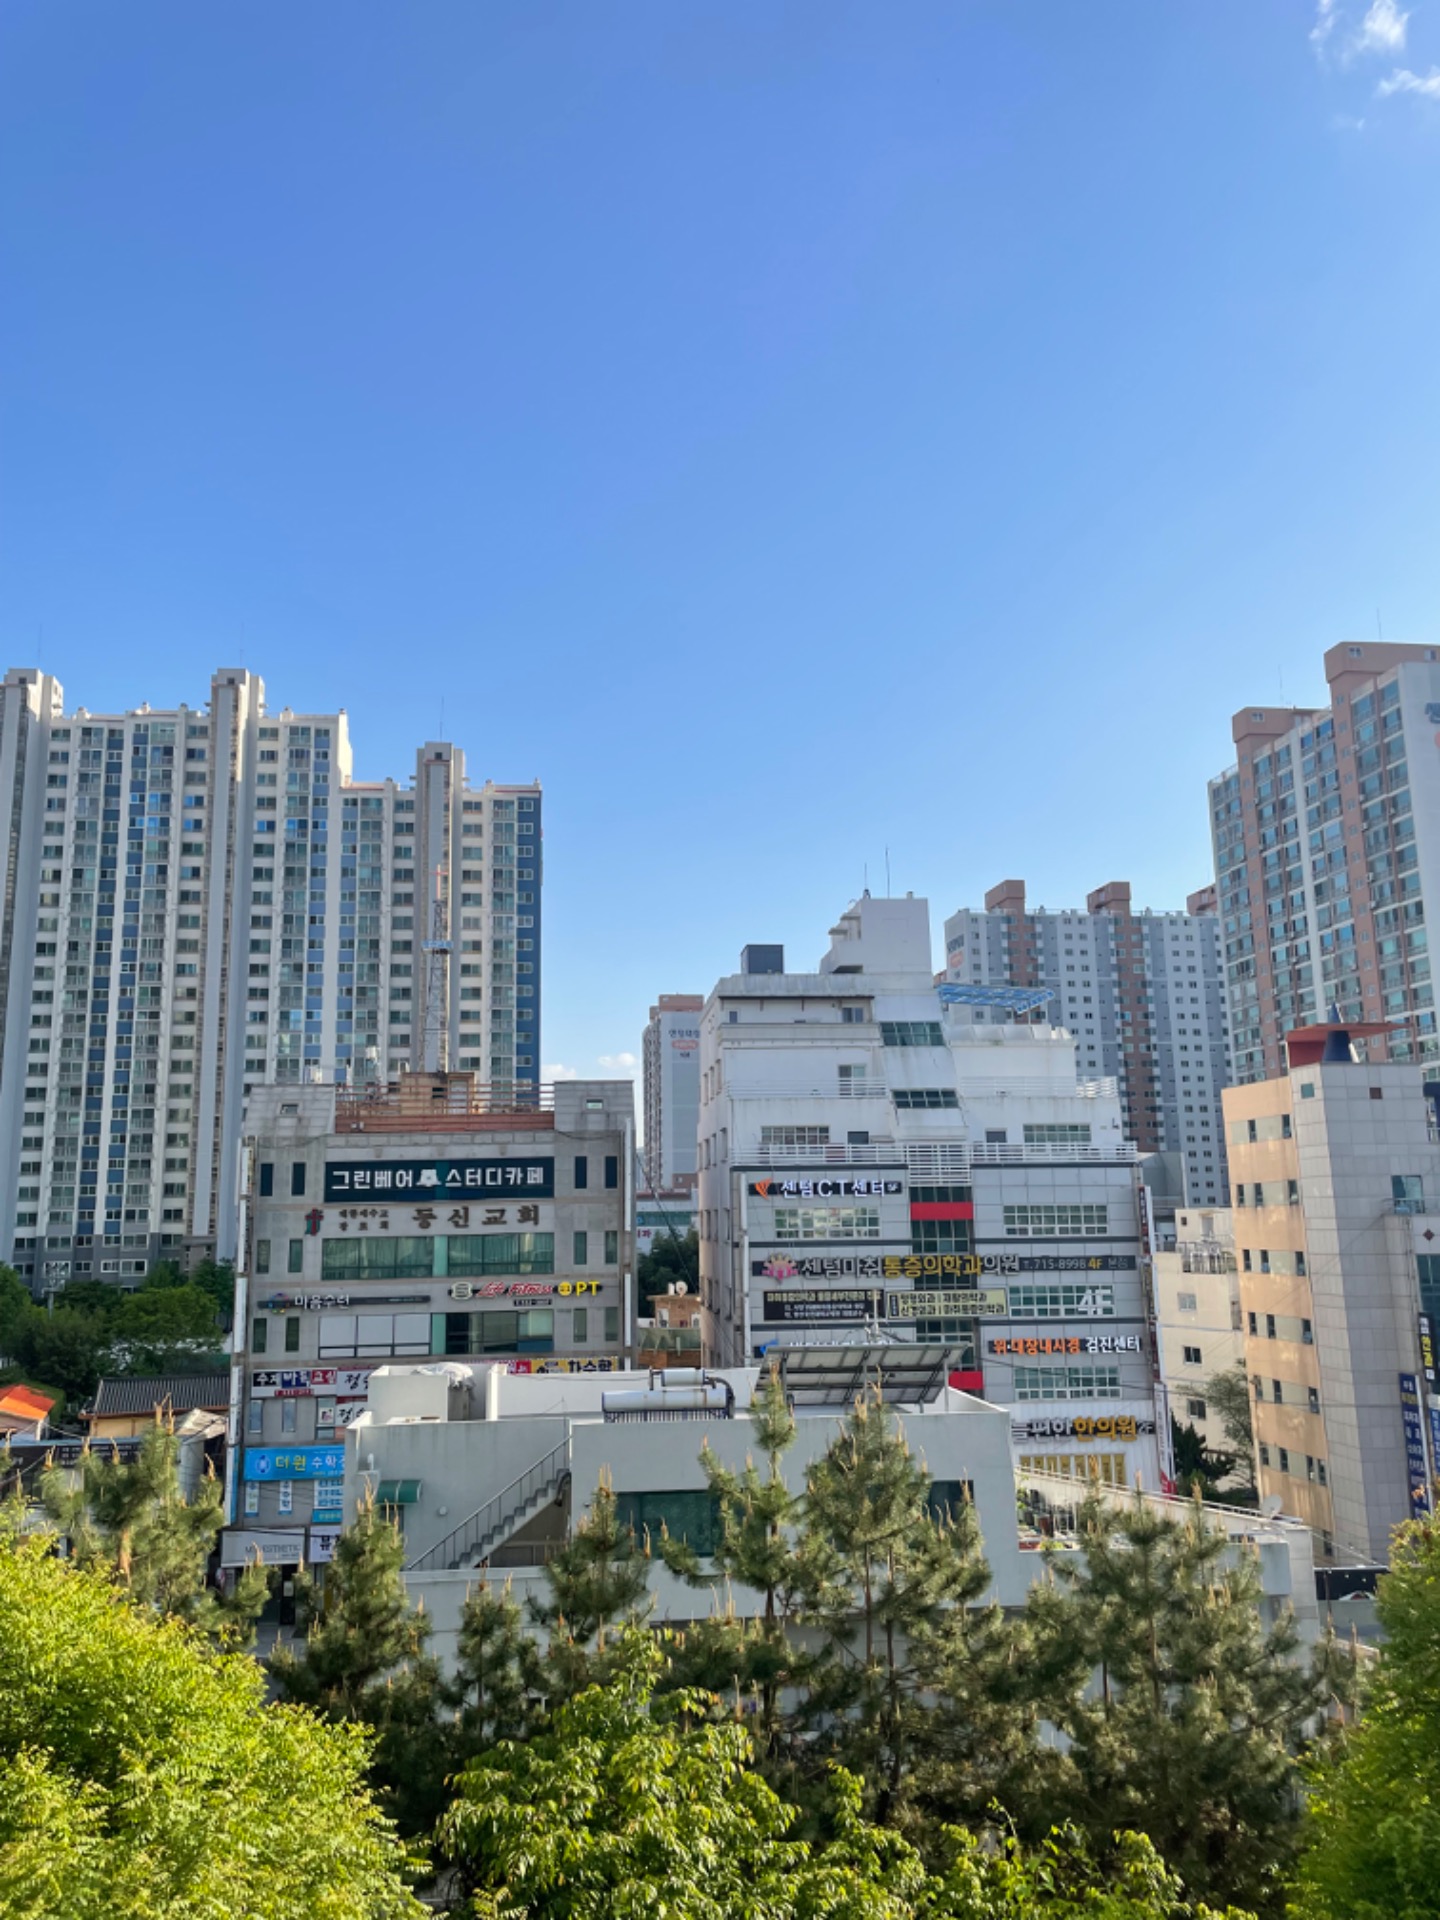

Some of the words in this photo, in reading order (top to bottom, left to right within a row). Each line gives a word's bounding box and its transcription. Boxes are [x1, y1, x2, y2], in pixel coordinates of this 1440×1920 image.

[331, 1169, 414, 1190] 그린베어
[444, 1167, 544, 1188] 스터디카페
[780, 1178, 885, 1199] 센텀CT센터
[412, 1204, 540, 1229] 동신교회
[801, 1254, 1020, 1279] 센텀마취통증의학과의원
[1088, 1257, 1103, 1269] 4F
[575, 1280, 600, 1297] PT
[294, 1294, 350, 1310] 마음수련
[1077, 1289, 1111, 1316] 4F
[1085, 1335, 1141, 1353] 검진센터
